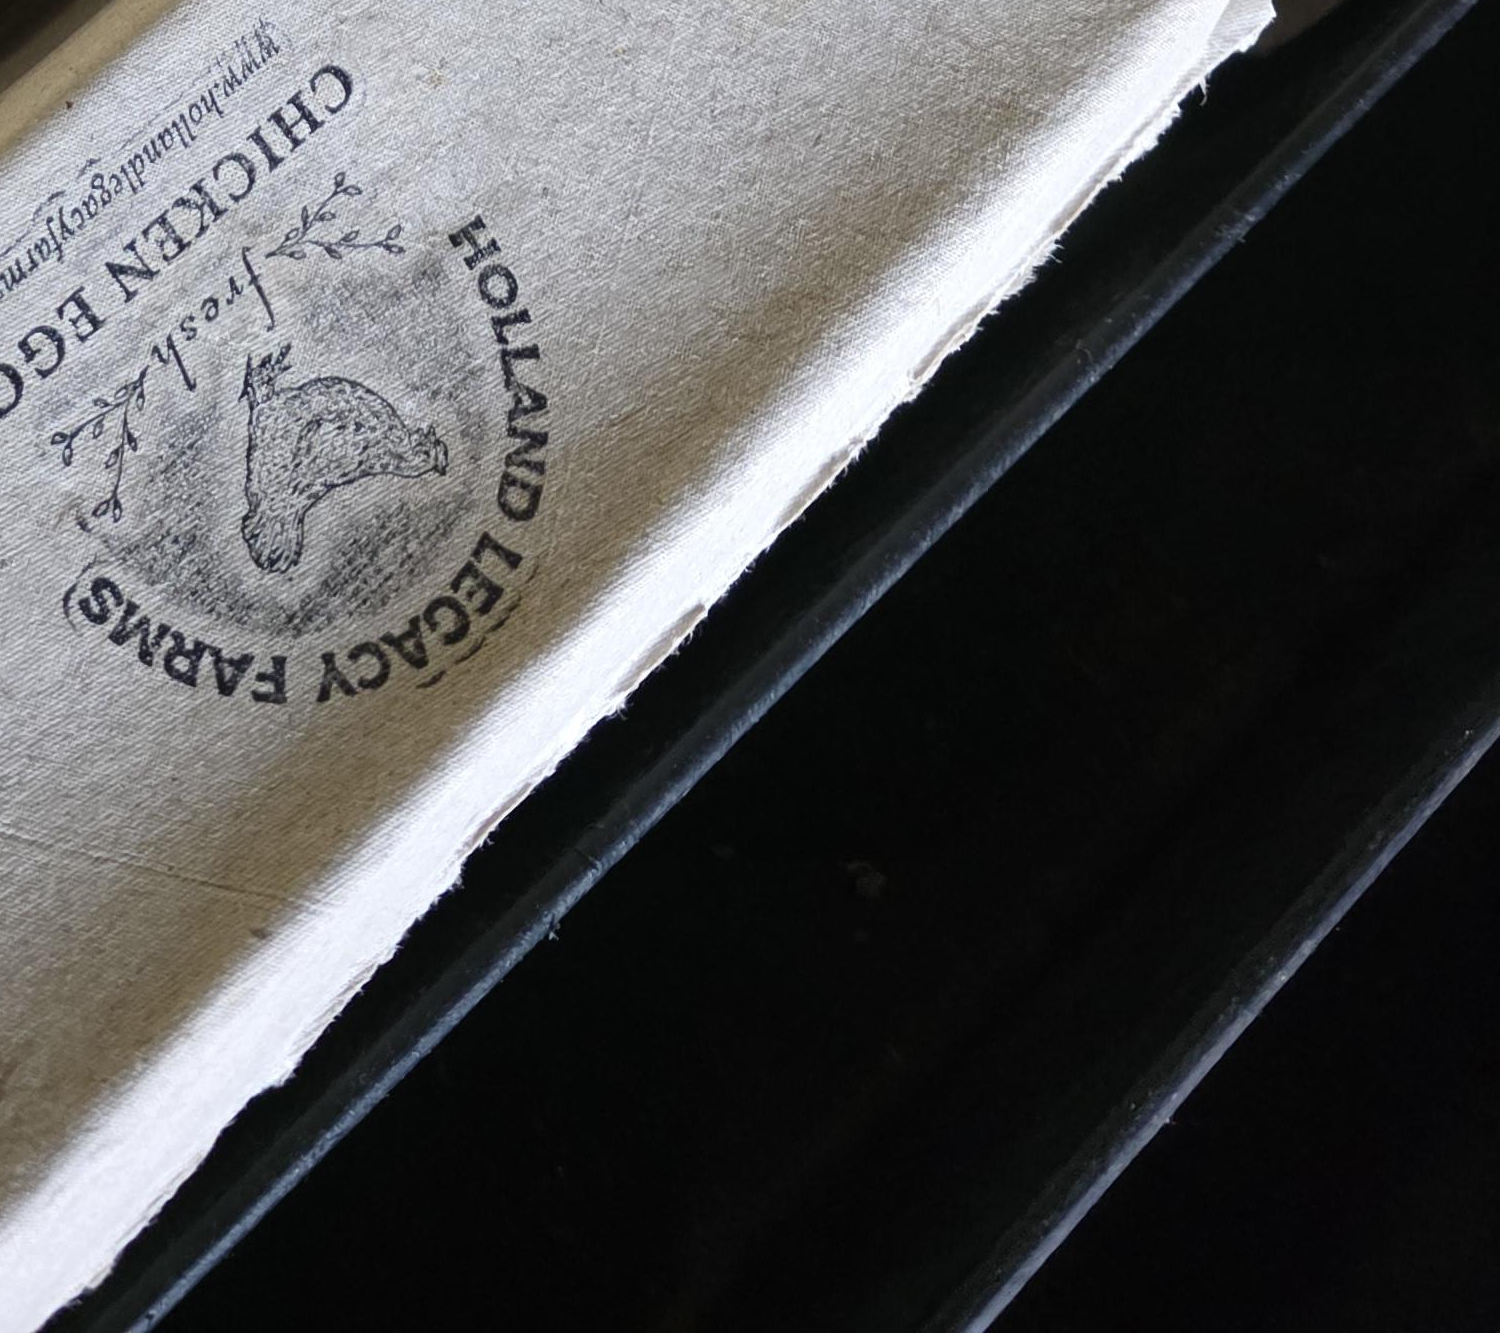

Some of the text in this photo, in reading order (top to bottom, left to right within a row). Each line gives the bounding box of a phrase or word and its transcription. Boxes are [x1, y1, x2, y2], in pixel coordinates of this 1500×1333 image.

[105, 63, 356, 304] CHICKEN
[150, 246, 276, 393] fresh
[79, 214, 549, 705] HOLLAND LEGACY FARMS
